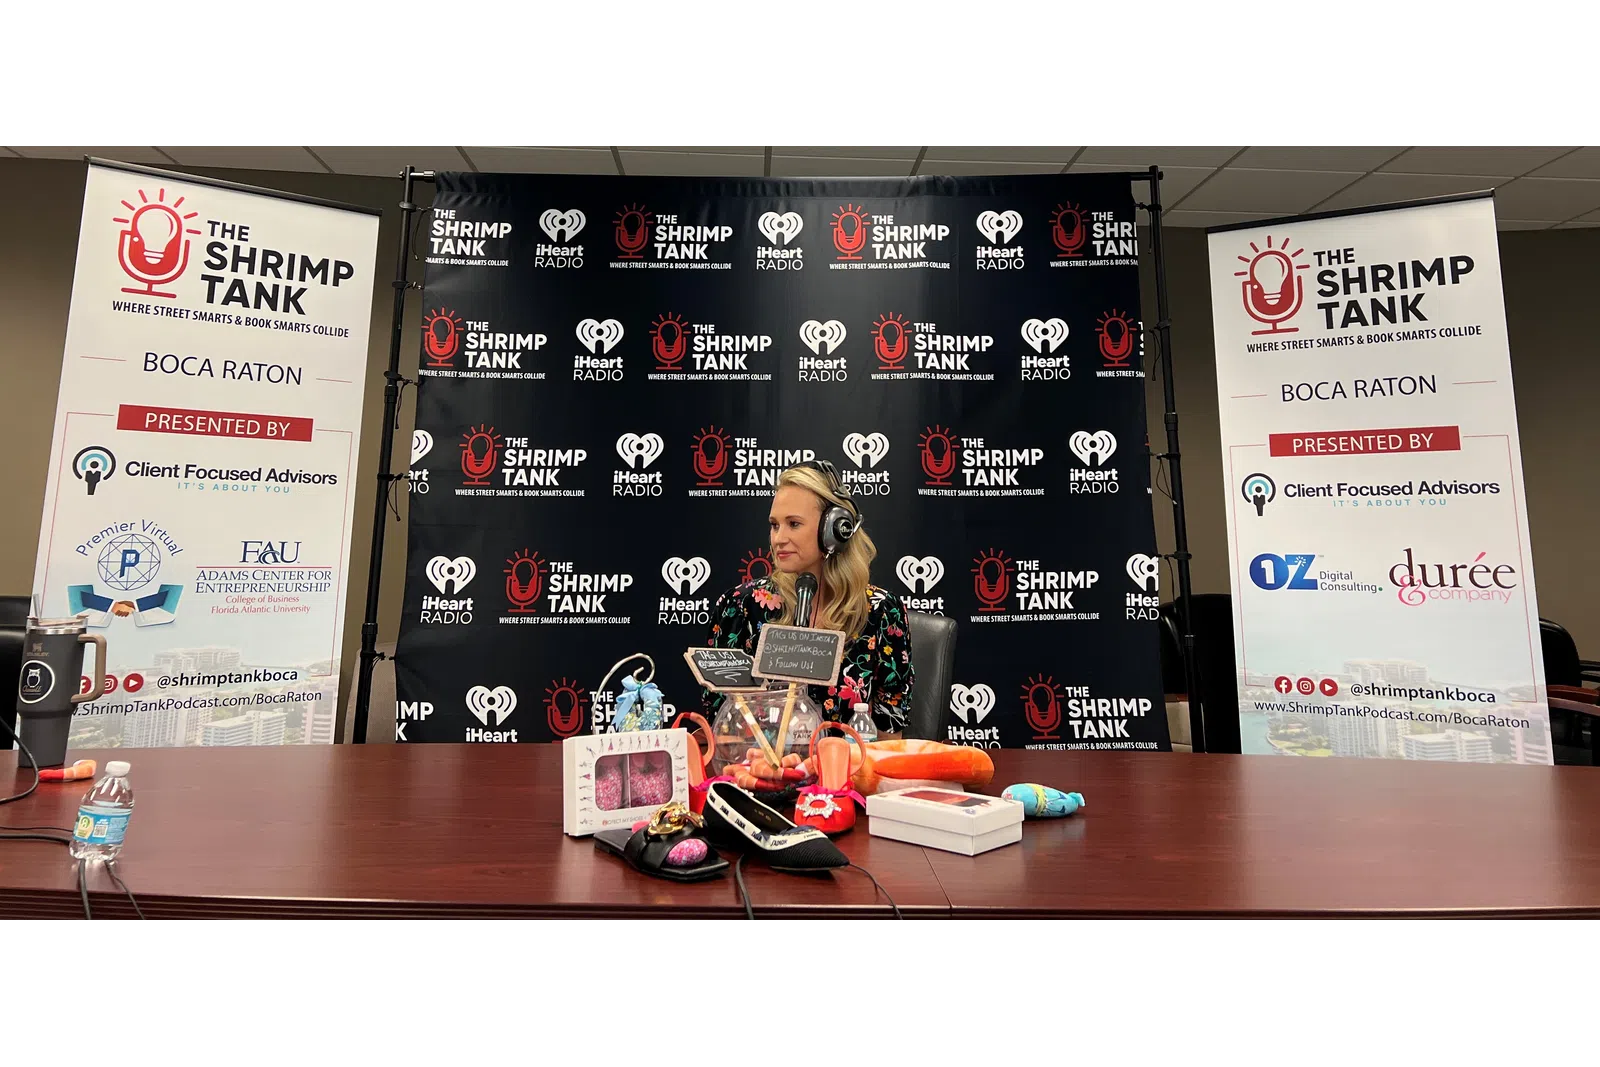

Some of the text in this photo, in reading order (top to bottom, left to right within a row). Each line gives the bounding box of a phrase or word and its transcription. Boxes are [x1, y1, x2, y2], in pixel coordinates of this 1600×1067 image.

[434, 208, 456, 219] THE
[656, 214, 678, 224] THE
[872, 215, 894, 225] THE
[1091, 211, 1113, 221] THE
[207, 220, 250, 242] THE
[431, 219, 512, 238] SHRIMP
[655, 225, 733, 242] SHRIMP
[872, 224, 950, 242] SHRIMP
[430, 237, 486, 256] TANK
[536, 243, 584, 256] iHeart
[654, 243, 708, 260] TANK
[757, 246, 803, 259] iHeart
[872, 242, 926, 260] TANK
[976, 246, 1024, 258] iHeart
[203, 241, 355, 288] SHRIMP
[534, 257, 583, 268] RADIO
[756, 259, 803, 270] RADIO
[976, 258, 1025, 270] RADIO
[1313, 247, 1355, 267] THE
[1316, 254, 1475, 298] SHRIMP
[200, 274, 308, 316] TANK
[113, 300, 349, 338] WHERE STREET SMARTS & BOOK SMARTS COLLIDE
[1317, 293, 1428, 330] TANK
[466, 321, 489, 331] THE
[692, 324, 715, 334] THE
[913, 322, 936, 333] THE
[465, 332, 547, 350] SHRIMP
[693, 335, 772, 352] SHRIMP
[914, 333, 994, 352] SHRIMP
[1246, 325, 1482, 353] WHERE STREET SMARTS & BOOK SMARTS COLLIDE
[464, 351, 521, 369] TANK
[574, 355, 623, 369] iHeart
[692, 354, 748, 370] TANK
[799, 356, 847, 369] iHeart
[914, 352, 970, 370] TANK
[1021, 355, 1070, 368] iHeart
[143, 352, 302, 385] BOCA RATON
[573, 369, 623, 381] RADIO
[799, 370, 847, 382] RADIO
[1021, 368, 1071, 381] RADIO
[1282, 375, 1436, 402] BOCA RATON
[145, 413, 290, 437] PRESENTED BY
[505, 437, 528, 448] THE
[734, 438, 757, 448] THE
[961, 438, 984, 448] THE
[1293, 433, 1433, 453] PRESENTED BY
[503, 449, 587, 466] SHRIMP
[733, 449, 816, 467] SHRIMP
[962, 448, 1044, 467] SHRIMP
[125, 461, 337, 485] Client Focused Advisors
[502, 468, 560, 486] TANK
[613, 470, 662, 484] iHeart
[842, 470, 889, 484] iHeart
[962, 468, 1019, 486] TANK
[1070, 468, 1118, 481] iHeart
[178, 482, 204, 490] IT'S
[212, 483, 257, 492] ABOUT
[613, 484, 662, 496] RADIO
[1070, 481, 1119, 494] RADIO
[1284, 480, 1500, 498] Client Focused Advisors
[1419, 498, 1446, 506] YOU
[75, 518, 184, 557] Premier Virtual
[549, 562, 573, 573] THE
[1016, 560, 1039, 571] THE
[1389, 547, 1517, 589] durée
[196, 569, 331, 581] ADAMS CENTER FOR
[549, 574, 633, 592] SHRIMP
[1016, 571, 1099, 590] SHRIMP
[1319, 570, 1353, 582] Digital
[195, 582, 331, 593] ENTREPRENEURSHIP
[1428, 586, 1513, 604] company
[225, 595, 300, 605] College of Business
[422, 595, 473, 611] iHeart
[547, 594, 606, 613] TANK
[659, 597, 709, 611] iHeart
[1016, 591, 1074, 610] TANK
[211, 605, 311, 614] Florida Atlantic University
[420, 611, 473, 624] RADIO
[658, 611, 709, 624] RADIO
[769, 630, 786, 639] TAG
[788, 631, 797, 640] US
[696, 651, 717, 660] TAG
[156, 668, 299, 690] @shrimptankboca
[1065, 686, 1090, 697] THE
[1350, 682, 1496, 704] @shrimptankboca
[72, 691, 323, 718] .ShrimpTankPodcast.com/BocaRaton
[1068, 698, 1152, 718] SHRIMP
[1254, 700, 1531, 729] www.ShrimpTankPodcast.com/BocaRaton
[466, 727, 518, 743] iHeart
[948, 725, 999, 740] iHeart
[1069, 719, 1130, 739] TANK
